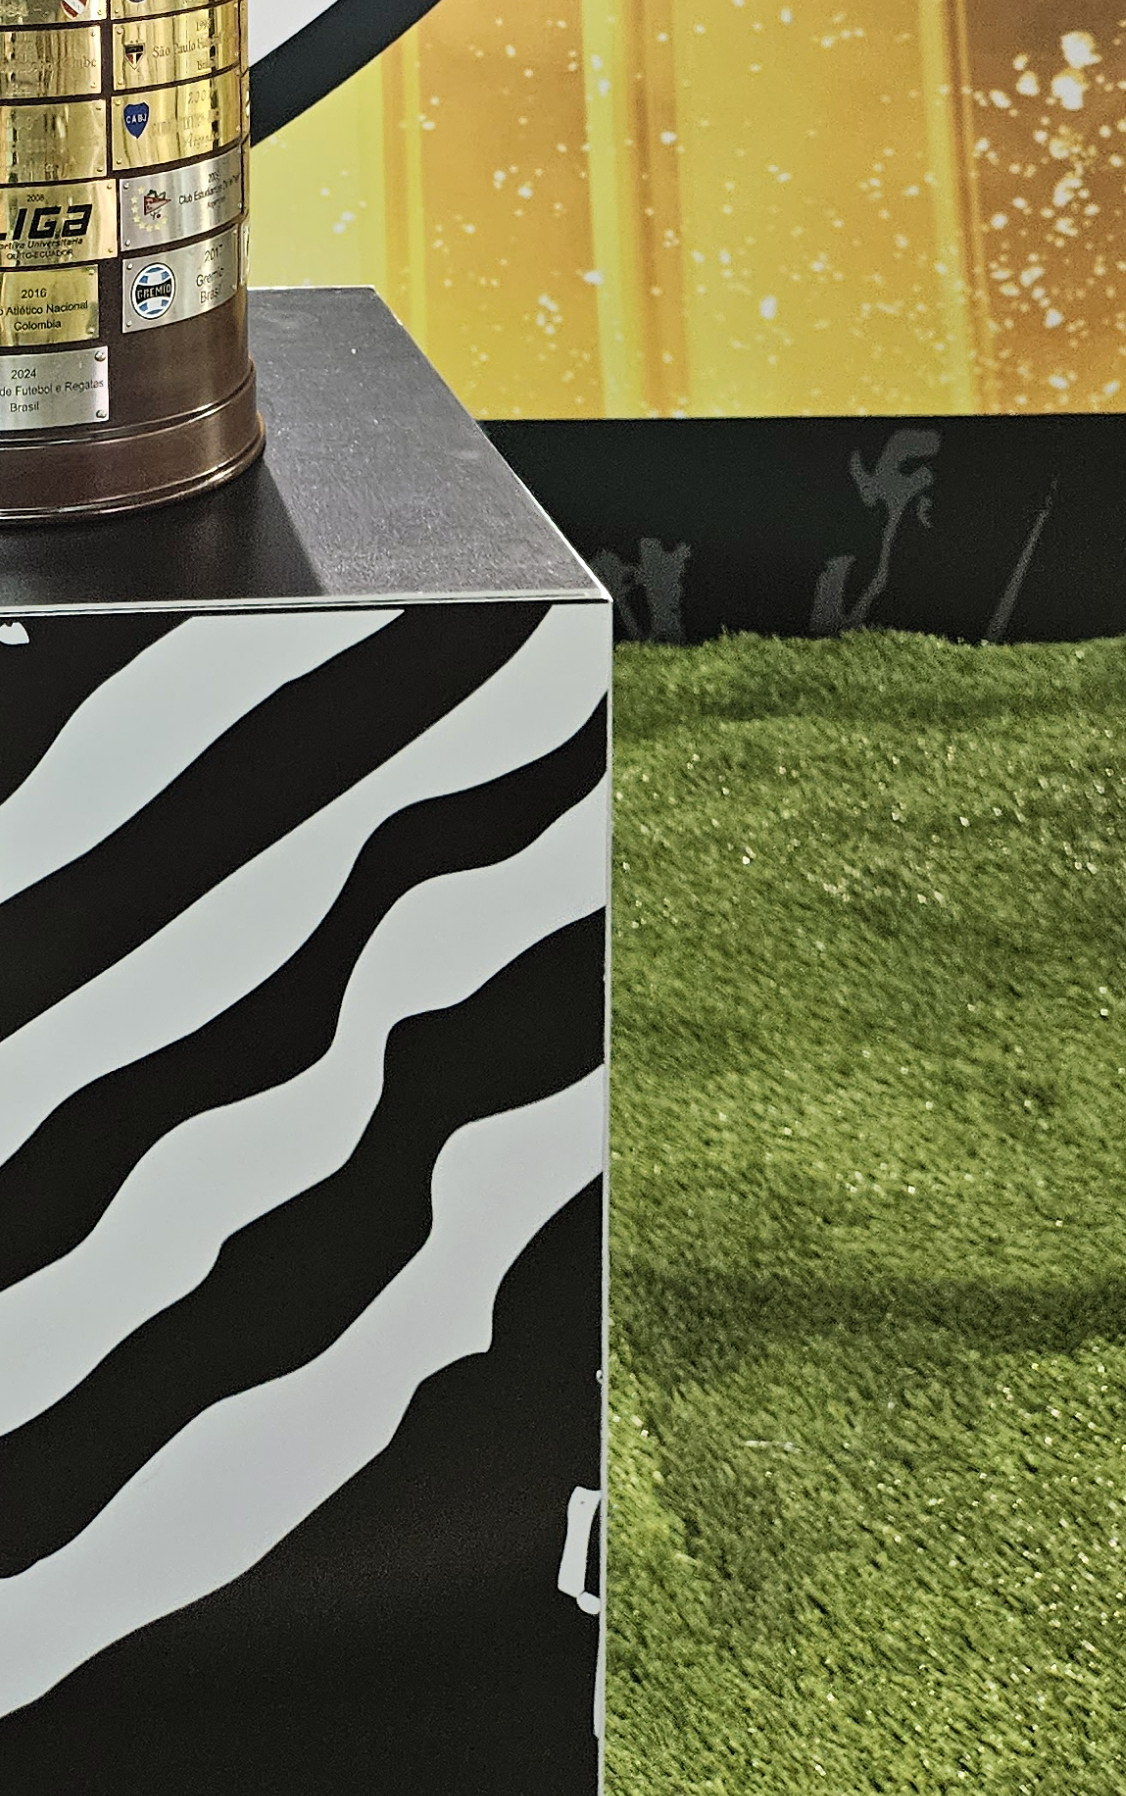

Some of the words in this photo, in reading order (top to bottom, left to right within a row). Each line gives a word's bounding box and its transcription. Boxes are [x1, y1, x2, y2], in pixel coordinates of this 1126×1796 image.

[125, 113, 147, 124] CABJ
[26, 193, 45, 203] 2008
[27, 237, 84, 249] Universitaria
[21, 288, 47, 299] 2016
[6, 305, 44, 317] Atlético
[46, 300, 89, 314] Nacional
[13, 319, 62, 332] Colombia
[11, 368, 38, 380] 2024
[0, 386, 12, 397] de
[15, 384, 53, 396] Futebol
[55, 385, 62, 393] e
[64, 378, 104, 392] Regatas
[10, 402, 40, 413] Brasil
